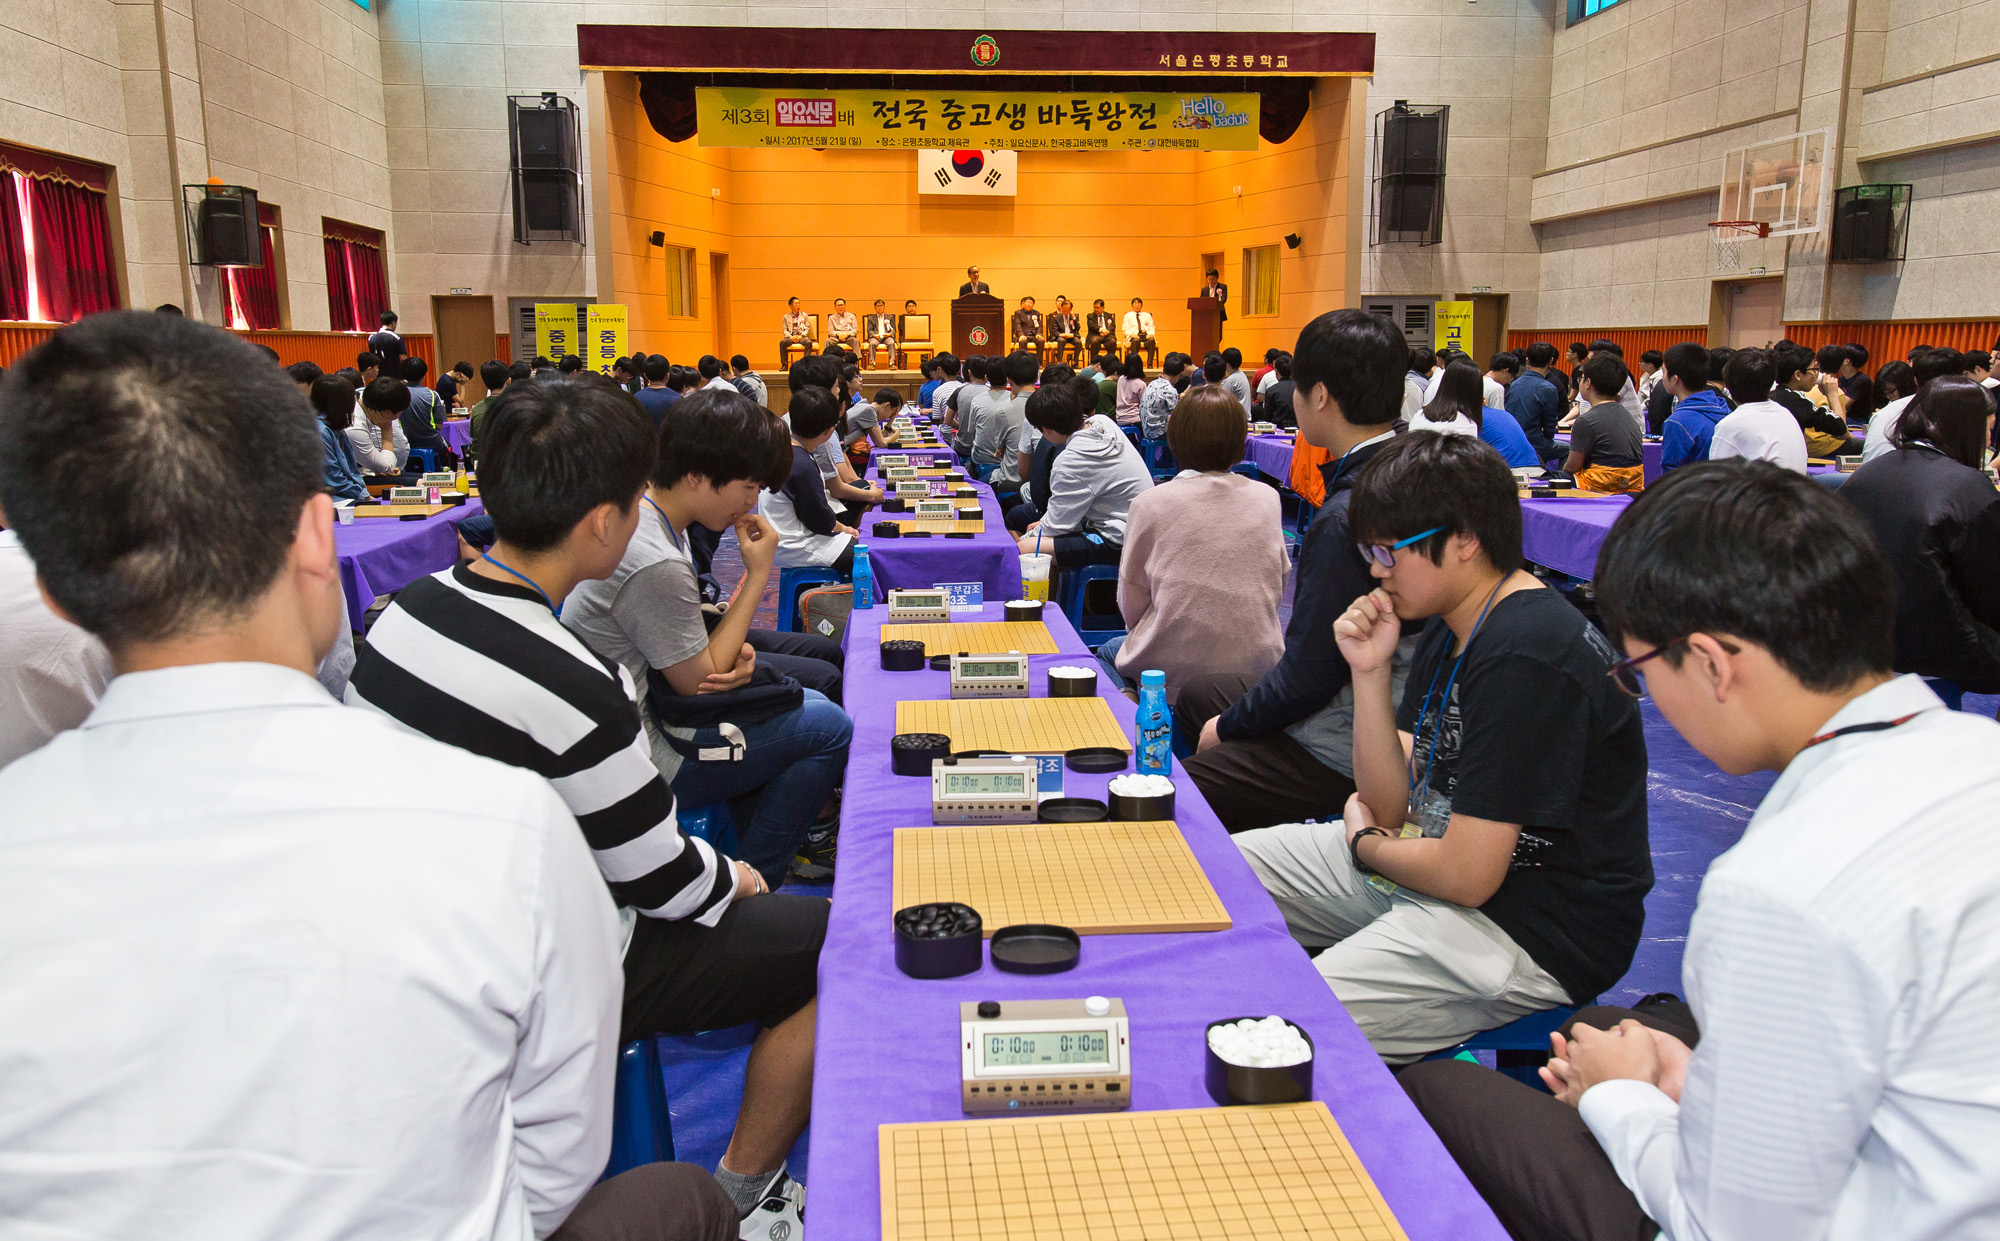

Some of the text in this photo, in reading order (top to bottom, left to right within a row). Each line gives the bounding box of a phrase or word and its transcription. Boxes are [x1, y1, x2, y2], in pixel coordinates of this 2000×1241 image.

[1159, 54, 1288, 68] 서울은평초등학교
[1180, 96, 1225, 116] Hello
[721, 99, 1157, 131] 제3회 일요신문 배 전국 중고생 바둑왕전
[1213, 112, 1250, 127] baduk
[786, 136, 814, 145] 2017년
[815, 136, 828, 145] 5월
[829, 136, 847, 145] 21일
[848, 136, 862, 146] (일)
[902, 137, 946, 147] 은평초등학교
[948, 138, 970, 147] 체육관
[1050, 138, 1108, 147] 한국중고바둑연맹
[1157, 138, 1199, 148] 대한바둑협회
